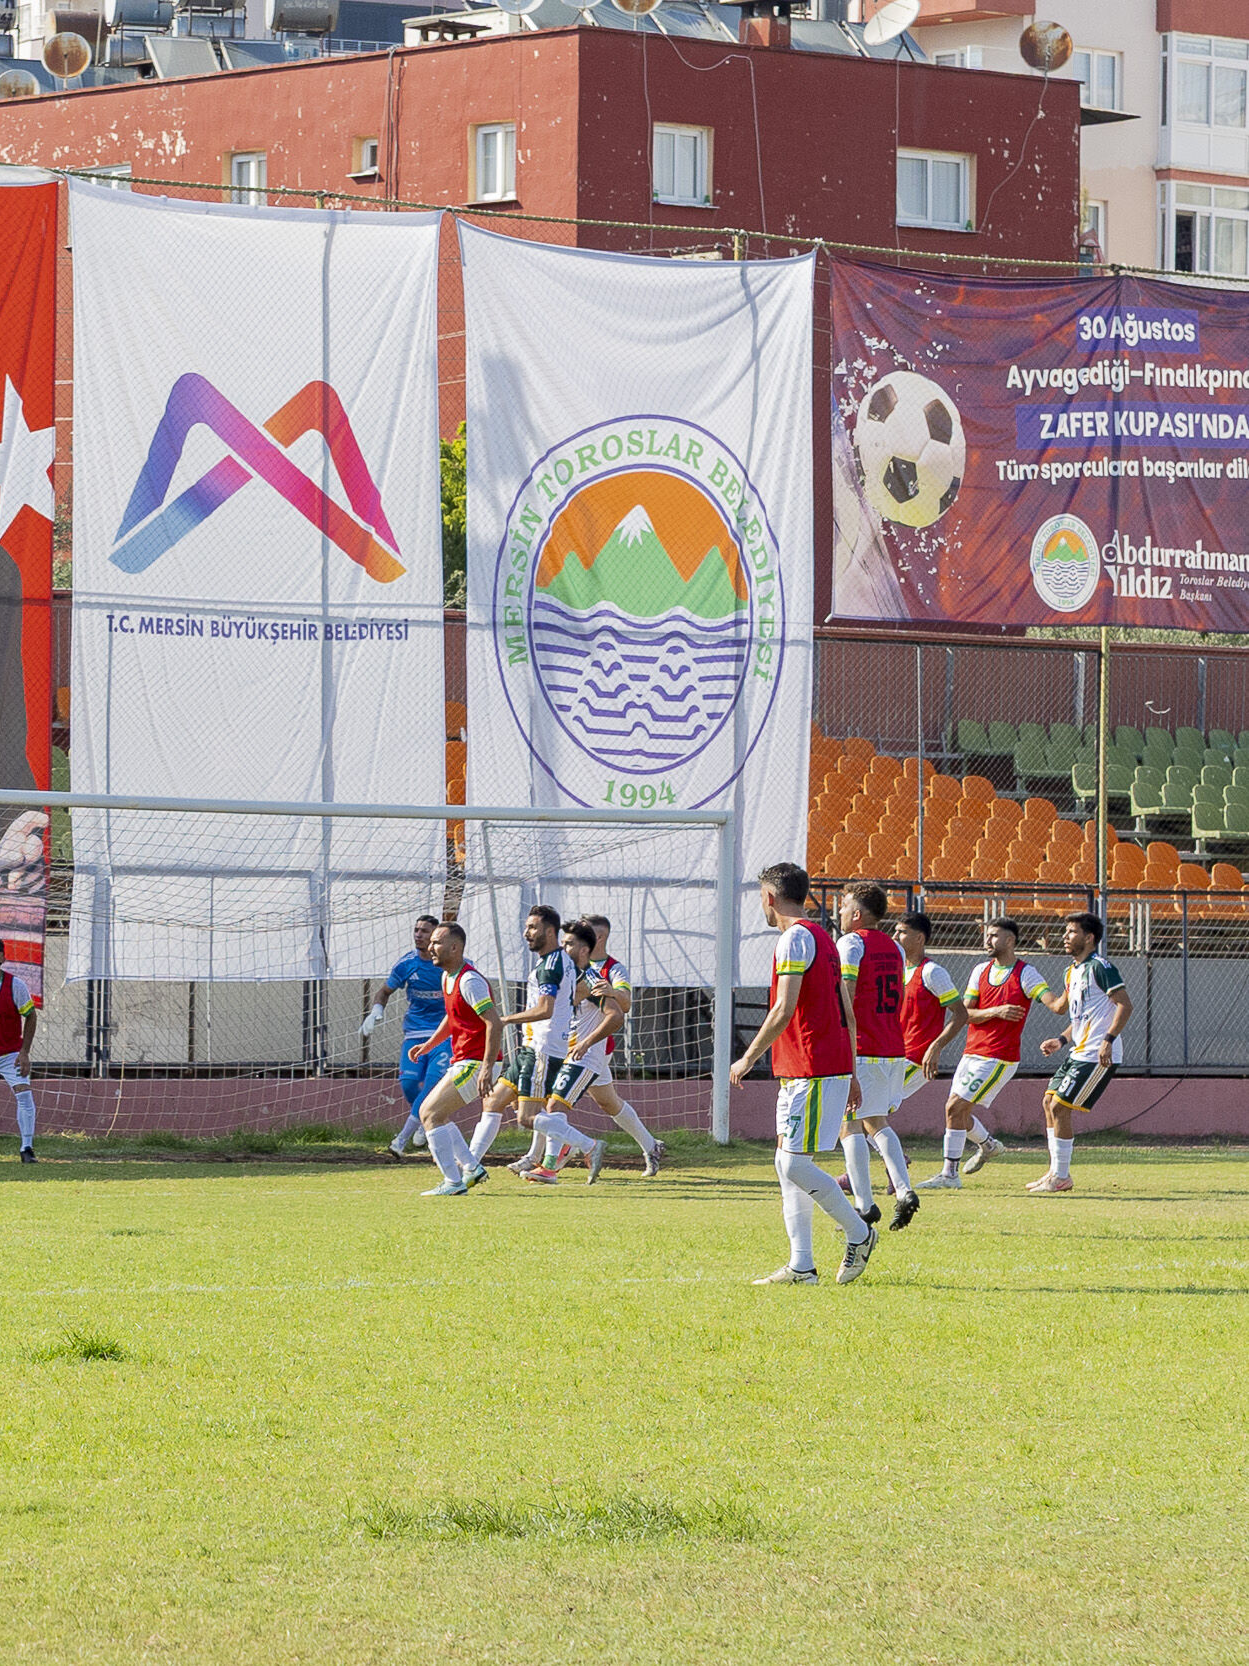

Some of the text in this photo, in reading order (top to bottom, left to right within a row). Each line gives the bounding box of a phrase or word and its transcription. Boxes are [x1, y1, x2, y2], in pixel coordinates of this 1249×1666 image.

[1079, 313, 1196, 347] 30 Ağustos
[1040, 411, 1109, 439] ZAFER
[996, 457, 1249, 485] Tüm sporculara başarılar dil
[504, 503, 543, 669] MERSİN
[536, 429, 705, 503] TOROSLAR
[1101, 529, 1249, 573] Abdurrahman
[1103, 565, 1173, 600] Yıldız
[1179, 574, 1214, 587] Toroslar
[1179, 588, 1212, 602] Başkanı
[106, 613, 409, 645] T.C. MERSİN BÜYÜKŞEHİR BELEDİYESİ
[602, 779, 677, 809] 1994
[875, 974, 900, 1014] 15
